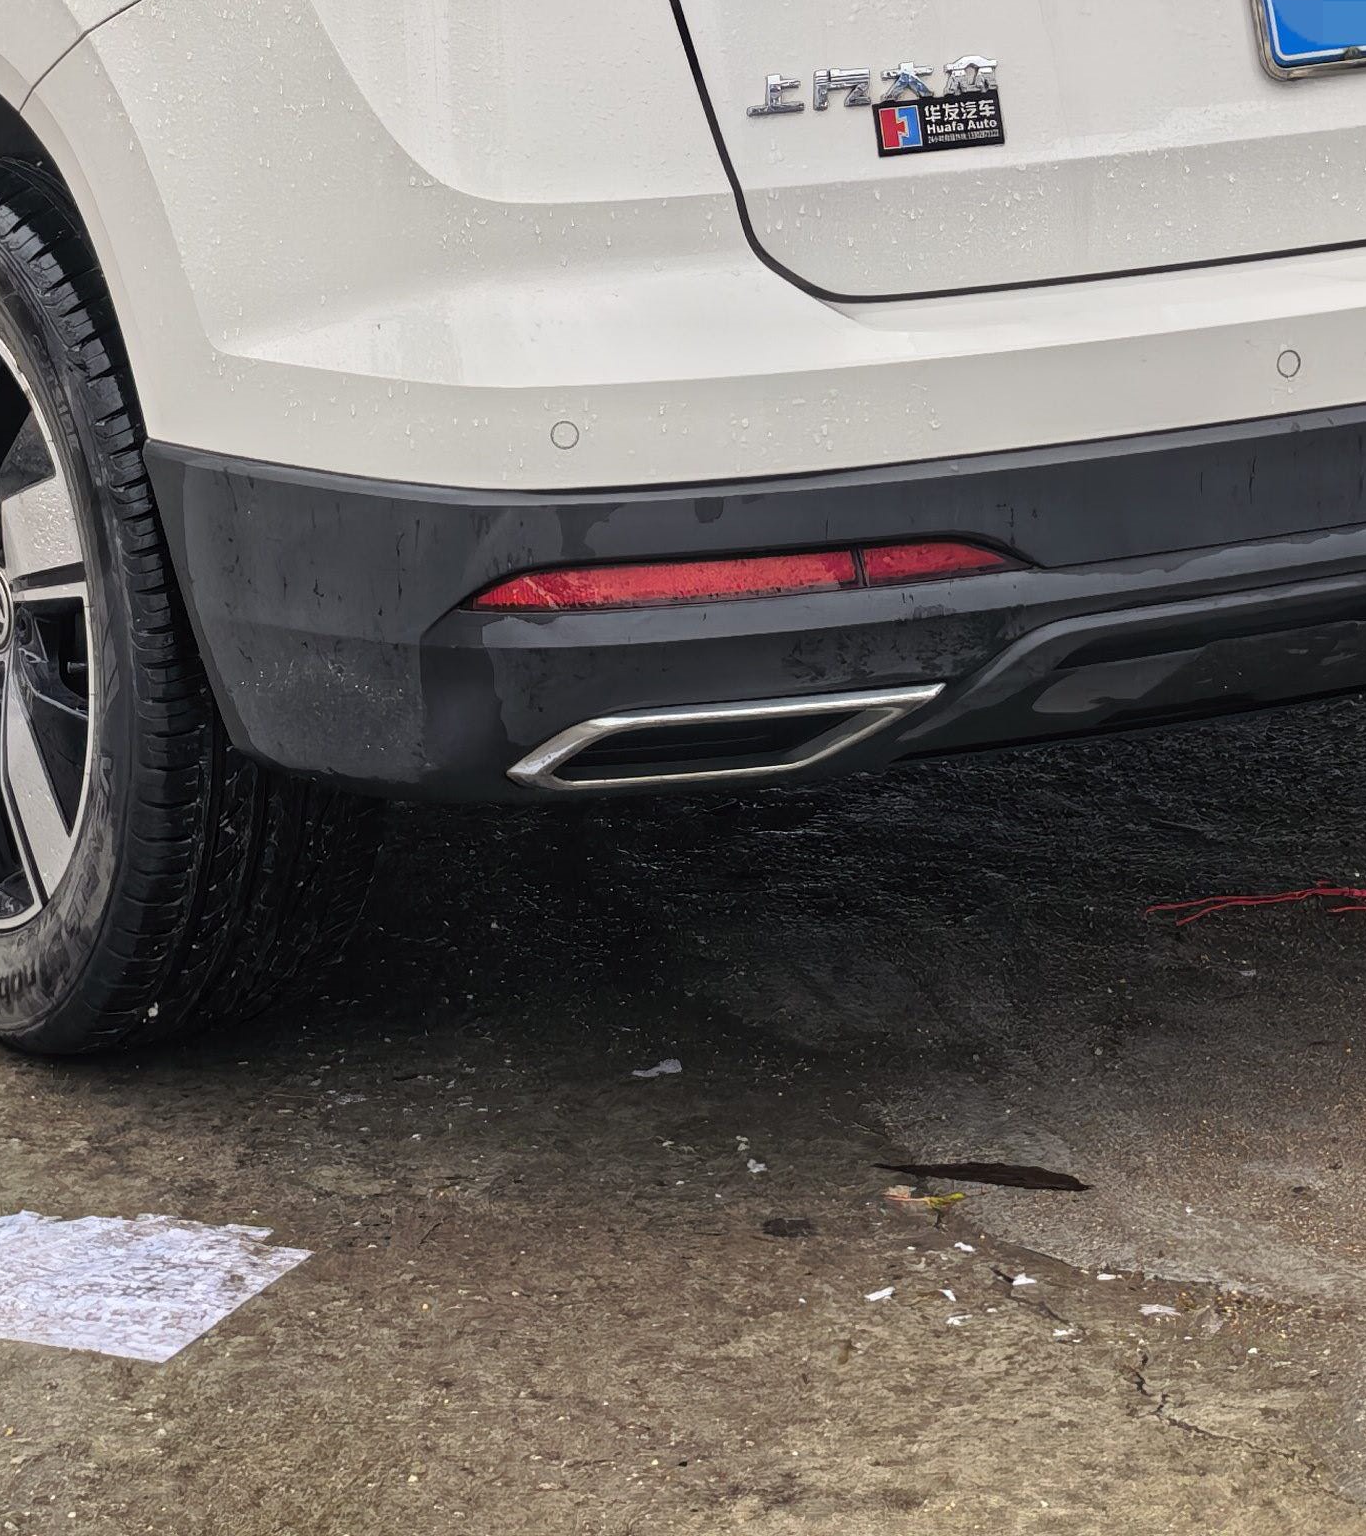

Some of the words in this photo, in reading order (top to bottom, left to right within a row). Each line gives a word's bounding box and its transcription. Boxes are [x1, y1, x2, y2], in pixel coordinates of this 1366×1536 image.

[924, 99, 996, 123] 华发汽车
[926, 120, 965, 135] Huafa
[967, 118, 998, 130] Auto
